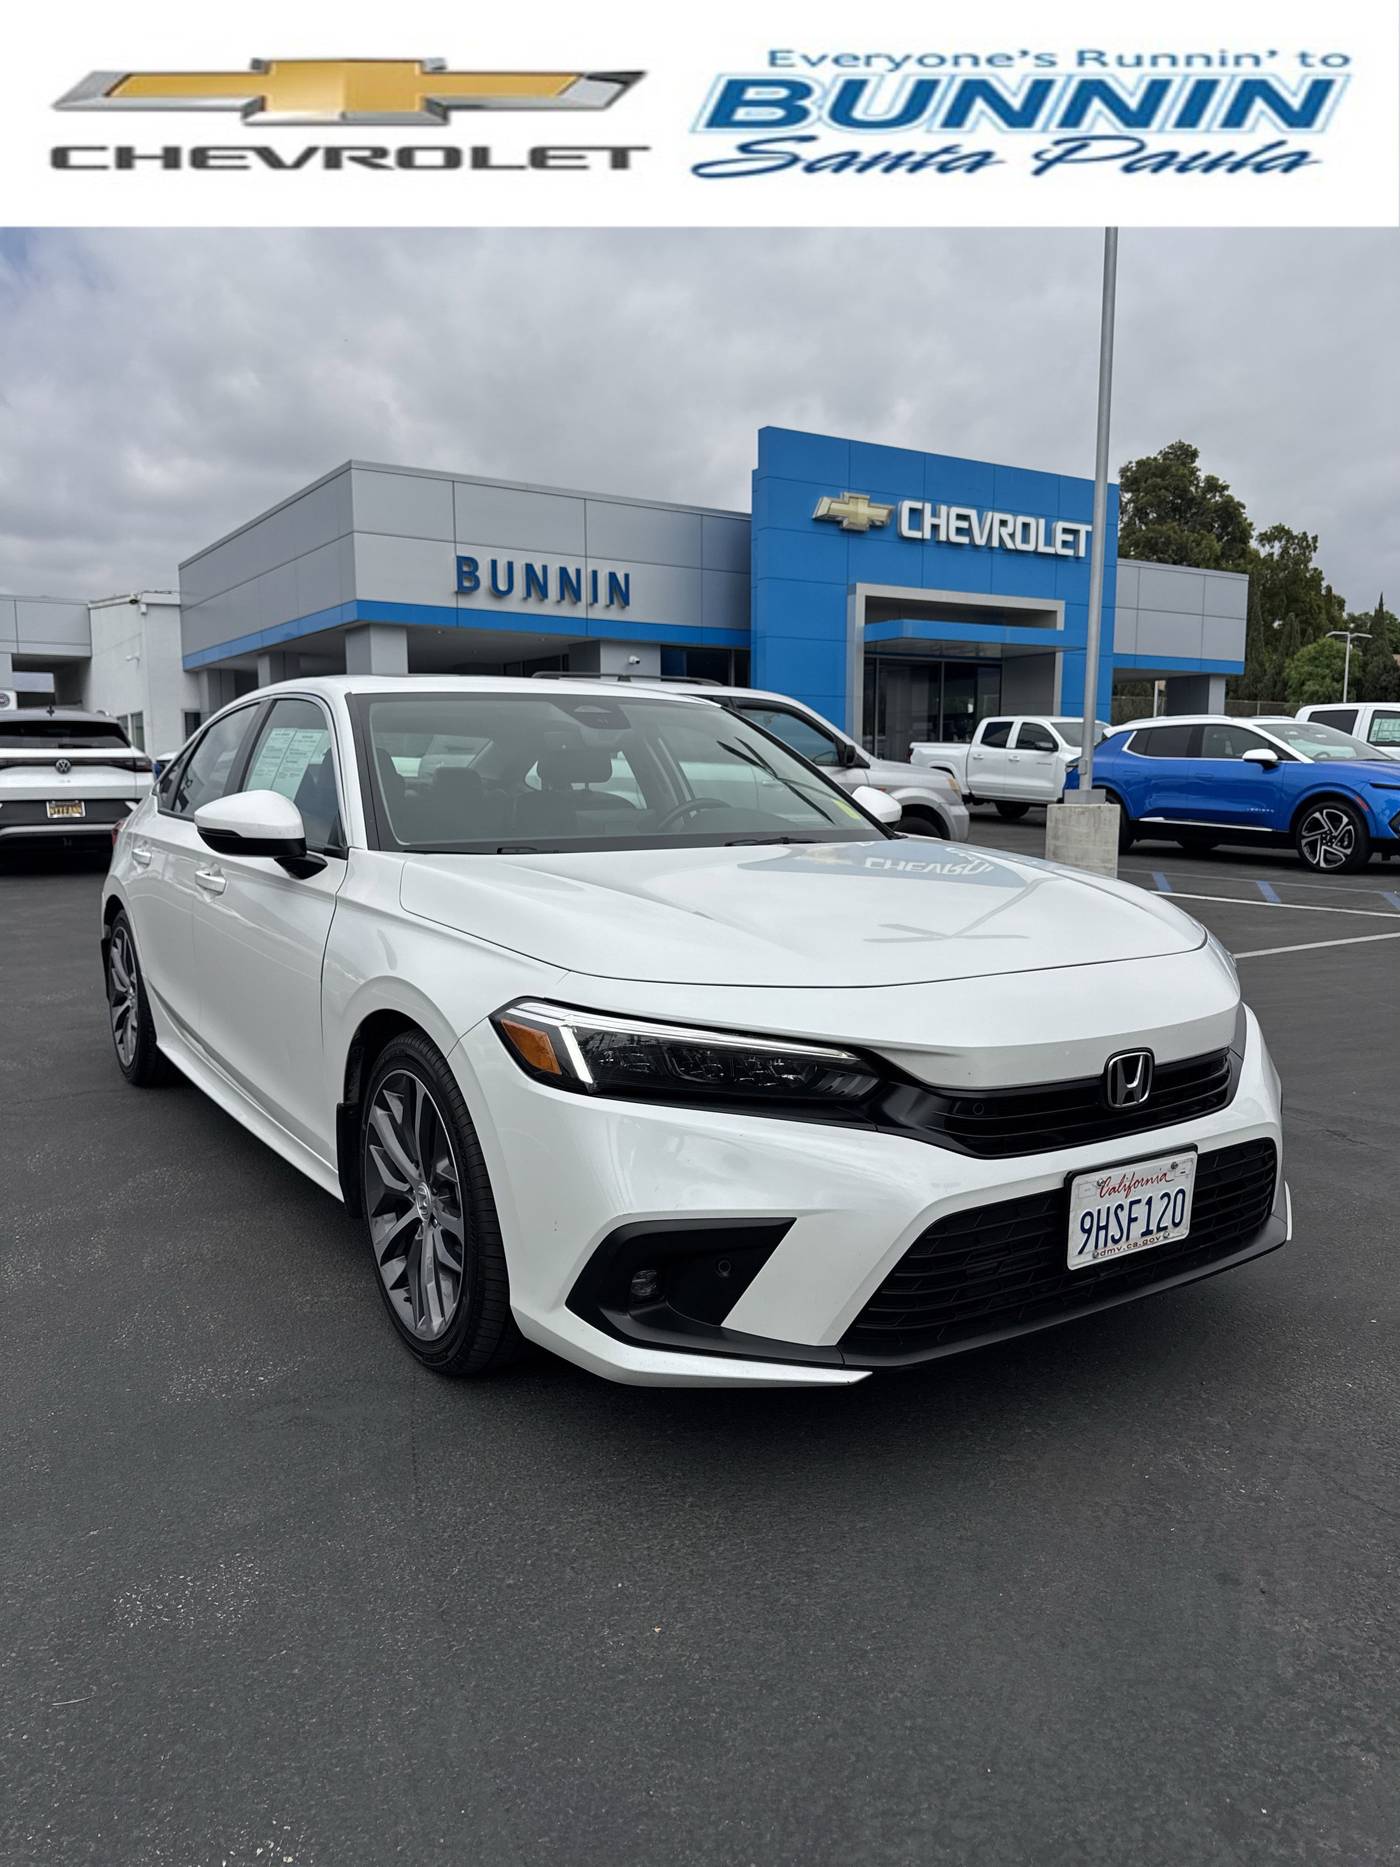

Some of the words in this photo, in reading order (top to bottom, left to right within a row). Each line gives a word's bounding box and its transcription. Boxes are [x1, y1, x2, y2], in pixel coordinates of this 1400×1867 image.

[898, 499, 1093, 558] CHEVROLET
[455, 554, 631, 608] BUNNIN
[1097, 1168, 1175, 1199] California
[1077, 1187, 1187, 1255] 9HSF120
[1099, 1236, 1161, 1257] dmv.ca.gov
